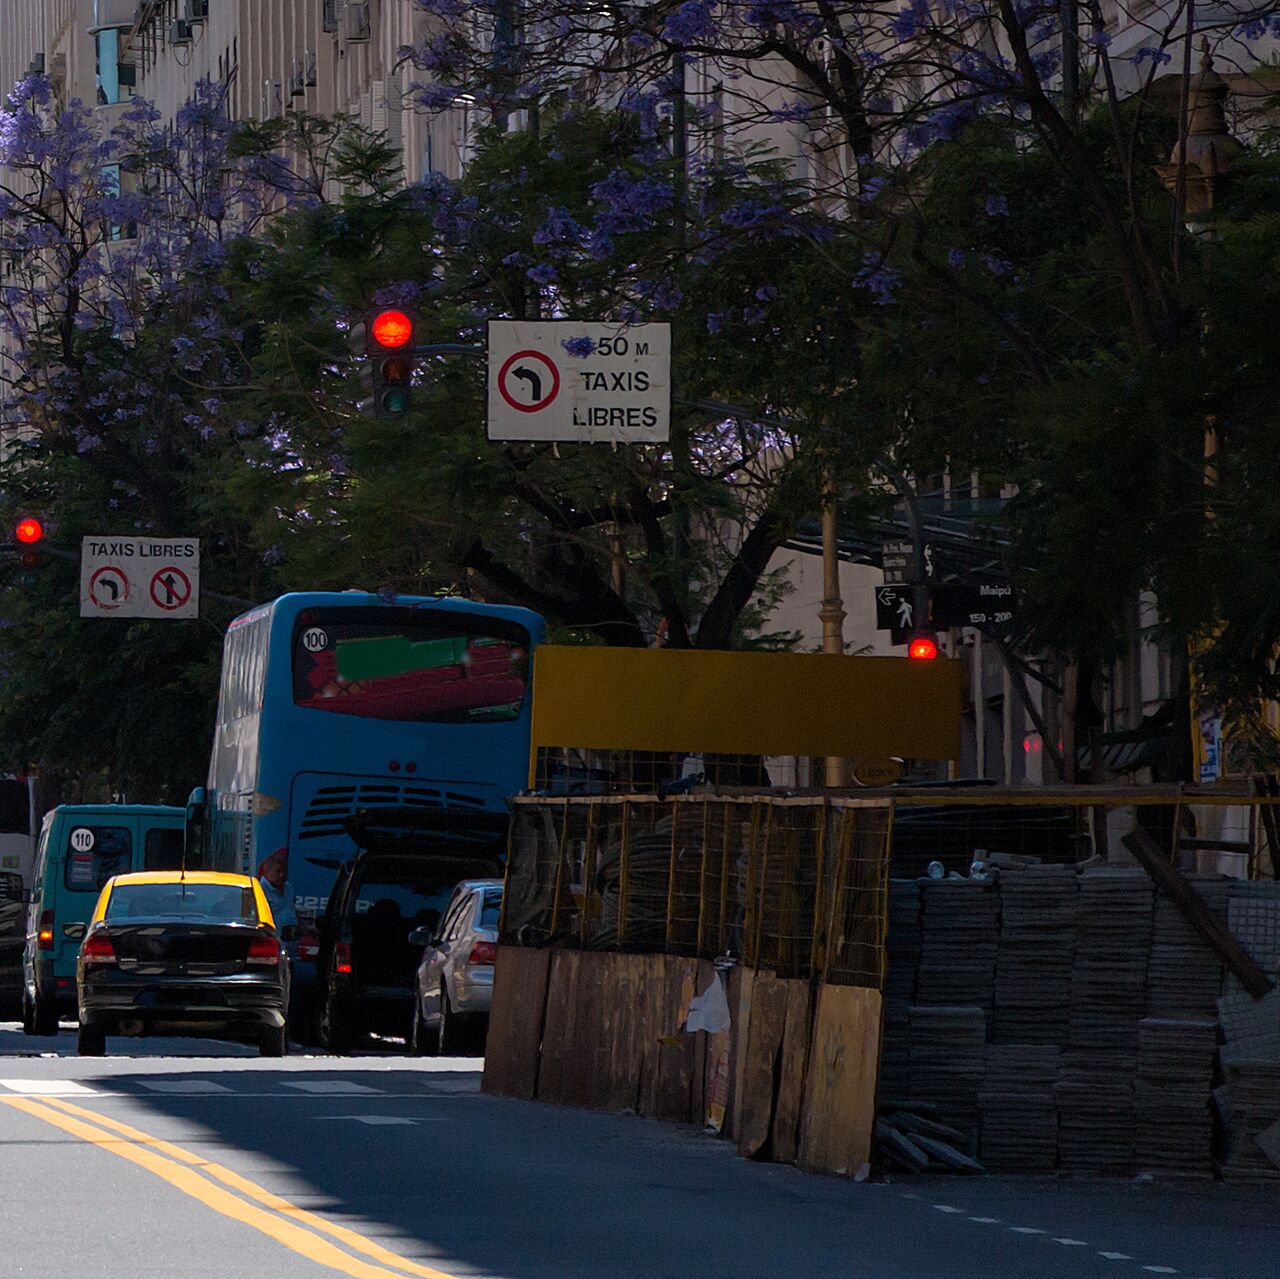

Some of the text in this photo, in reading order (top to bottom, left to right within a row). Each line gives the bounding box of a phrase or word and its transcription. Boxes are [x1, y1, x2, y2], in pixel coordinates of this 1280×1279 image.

[580, 372, 649, 391] TAXIS
[573, 407, 657, 427] LIBRES
[91, 542, 194, 557] TAXIS LIBRES
[980, 585, 1011, 597] Maipú
[306, 632, 326, 648] 100
[75, 833, 91, 847] 110
